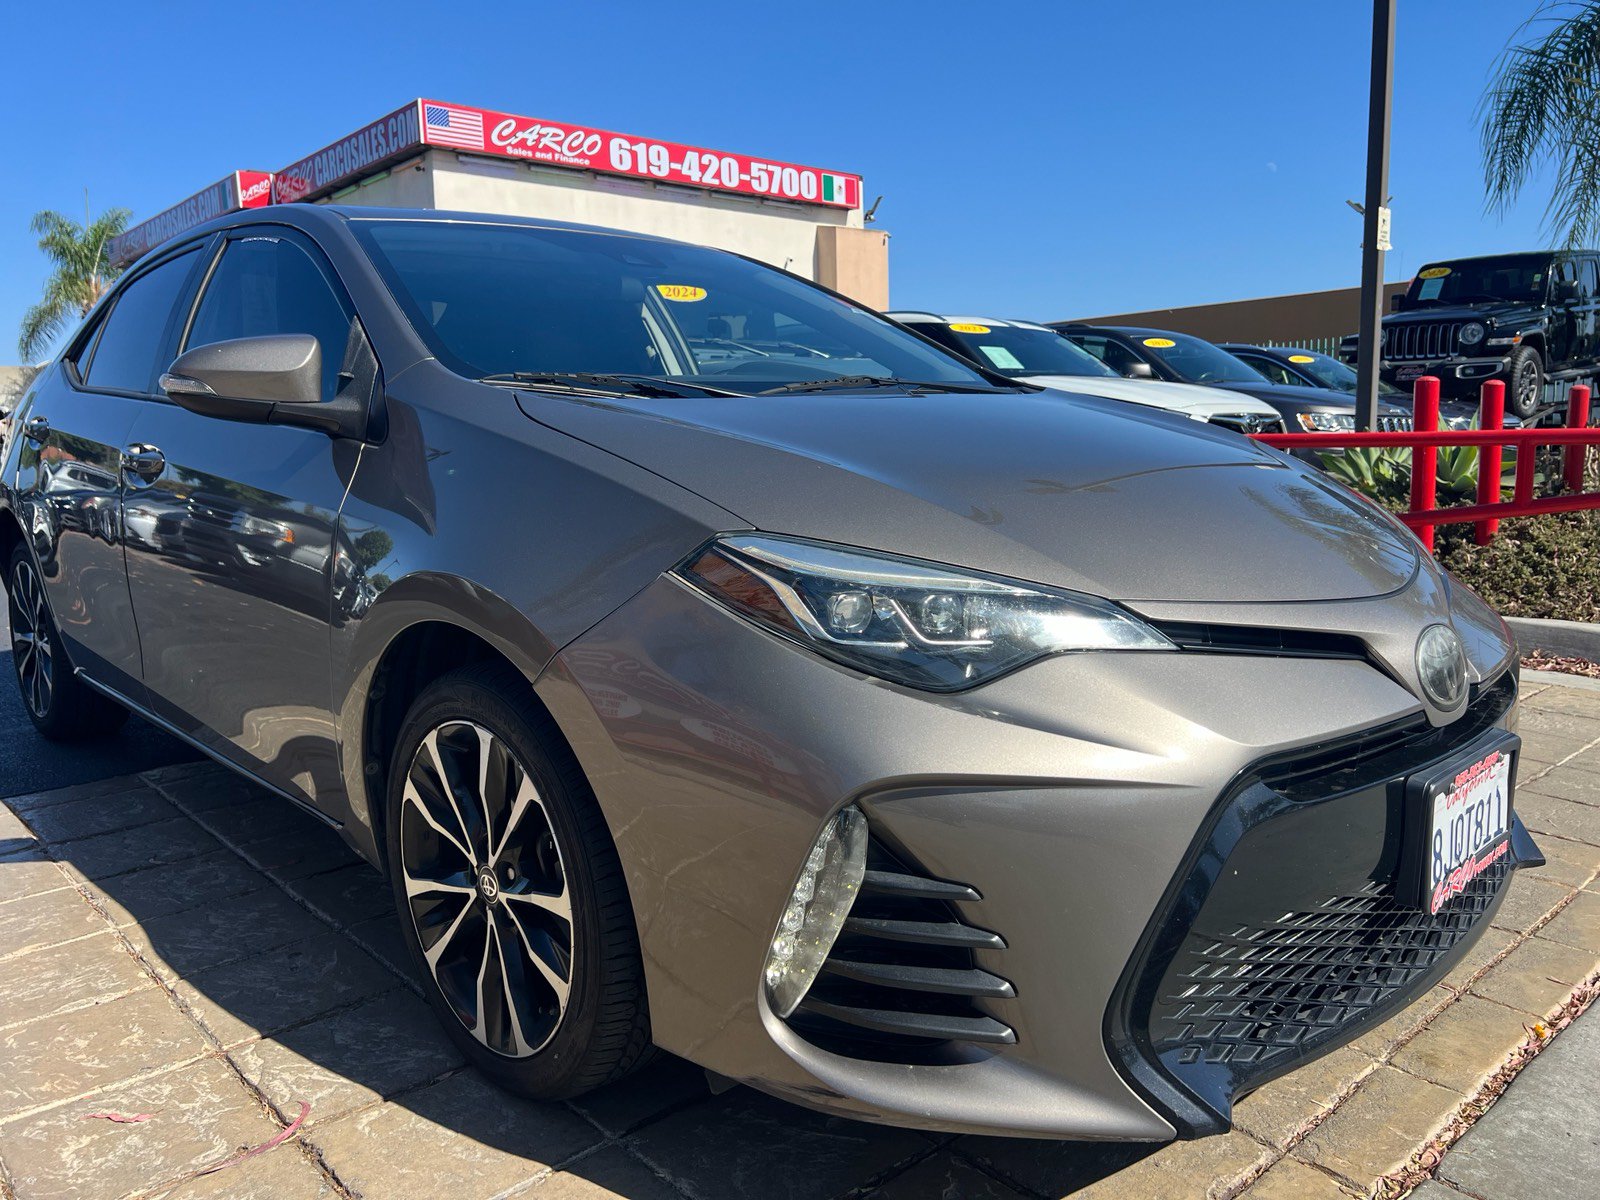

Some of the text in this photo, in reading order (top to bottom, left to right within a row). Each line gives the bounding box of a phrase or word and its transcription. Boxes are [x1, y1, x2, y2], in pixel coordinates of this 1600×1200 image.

[314, 107, 418, 187] CARCOSALES.COM
[491, 119, 602, 157] CARCO
[506, 145, 590, 166] Sales and Finance
[241, 179, 270, 202] CARCO
[609, 137, 817, 200] 619-420-5700
[145, 186, 220, 249] CARCOSALES.COM
[665, 286, 698, 298] 2024
[1432, 785, 1504, 885] 8JQT811
